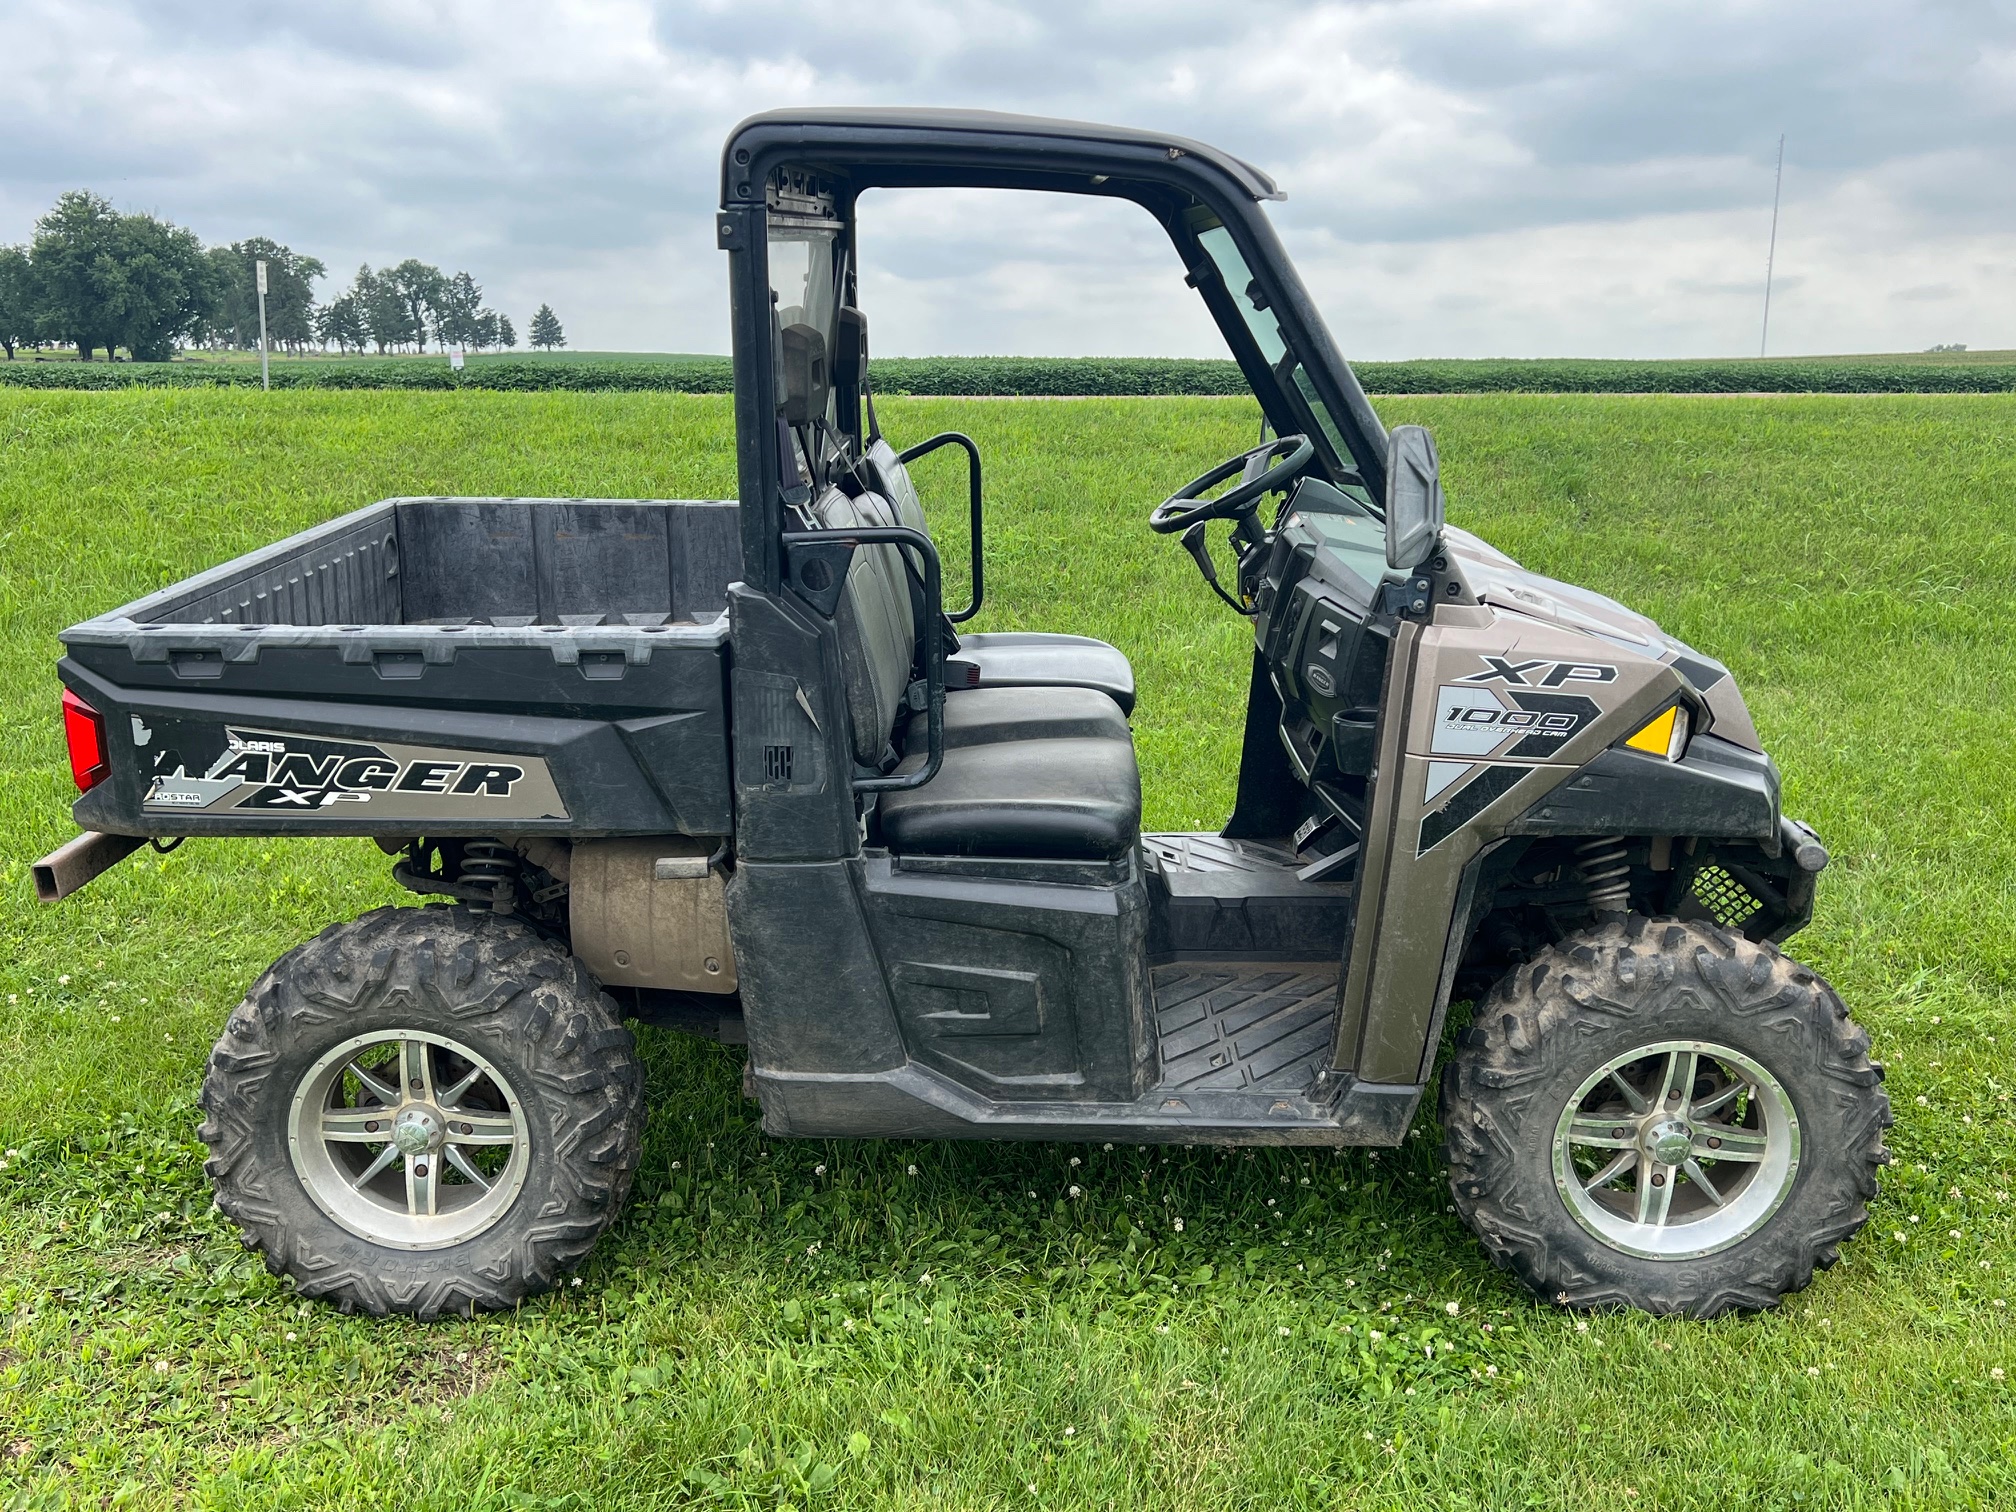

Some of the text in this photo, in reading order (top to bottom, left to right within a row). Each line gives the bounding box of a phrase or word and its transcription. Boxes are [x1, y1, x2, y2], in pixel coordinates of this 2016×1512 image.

[1450, 655, 1619, 689] XP
[1444, 705, 1578, 731] 1000
[1480, 726, 1540, 736] OVERHEAD
[1542, 730, 1568, 738] CAM
[228, 740, 286, 753] OLARIS
[154, 792, 200, 801] ROSTAR
[267, 789, 373, 806] XP
